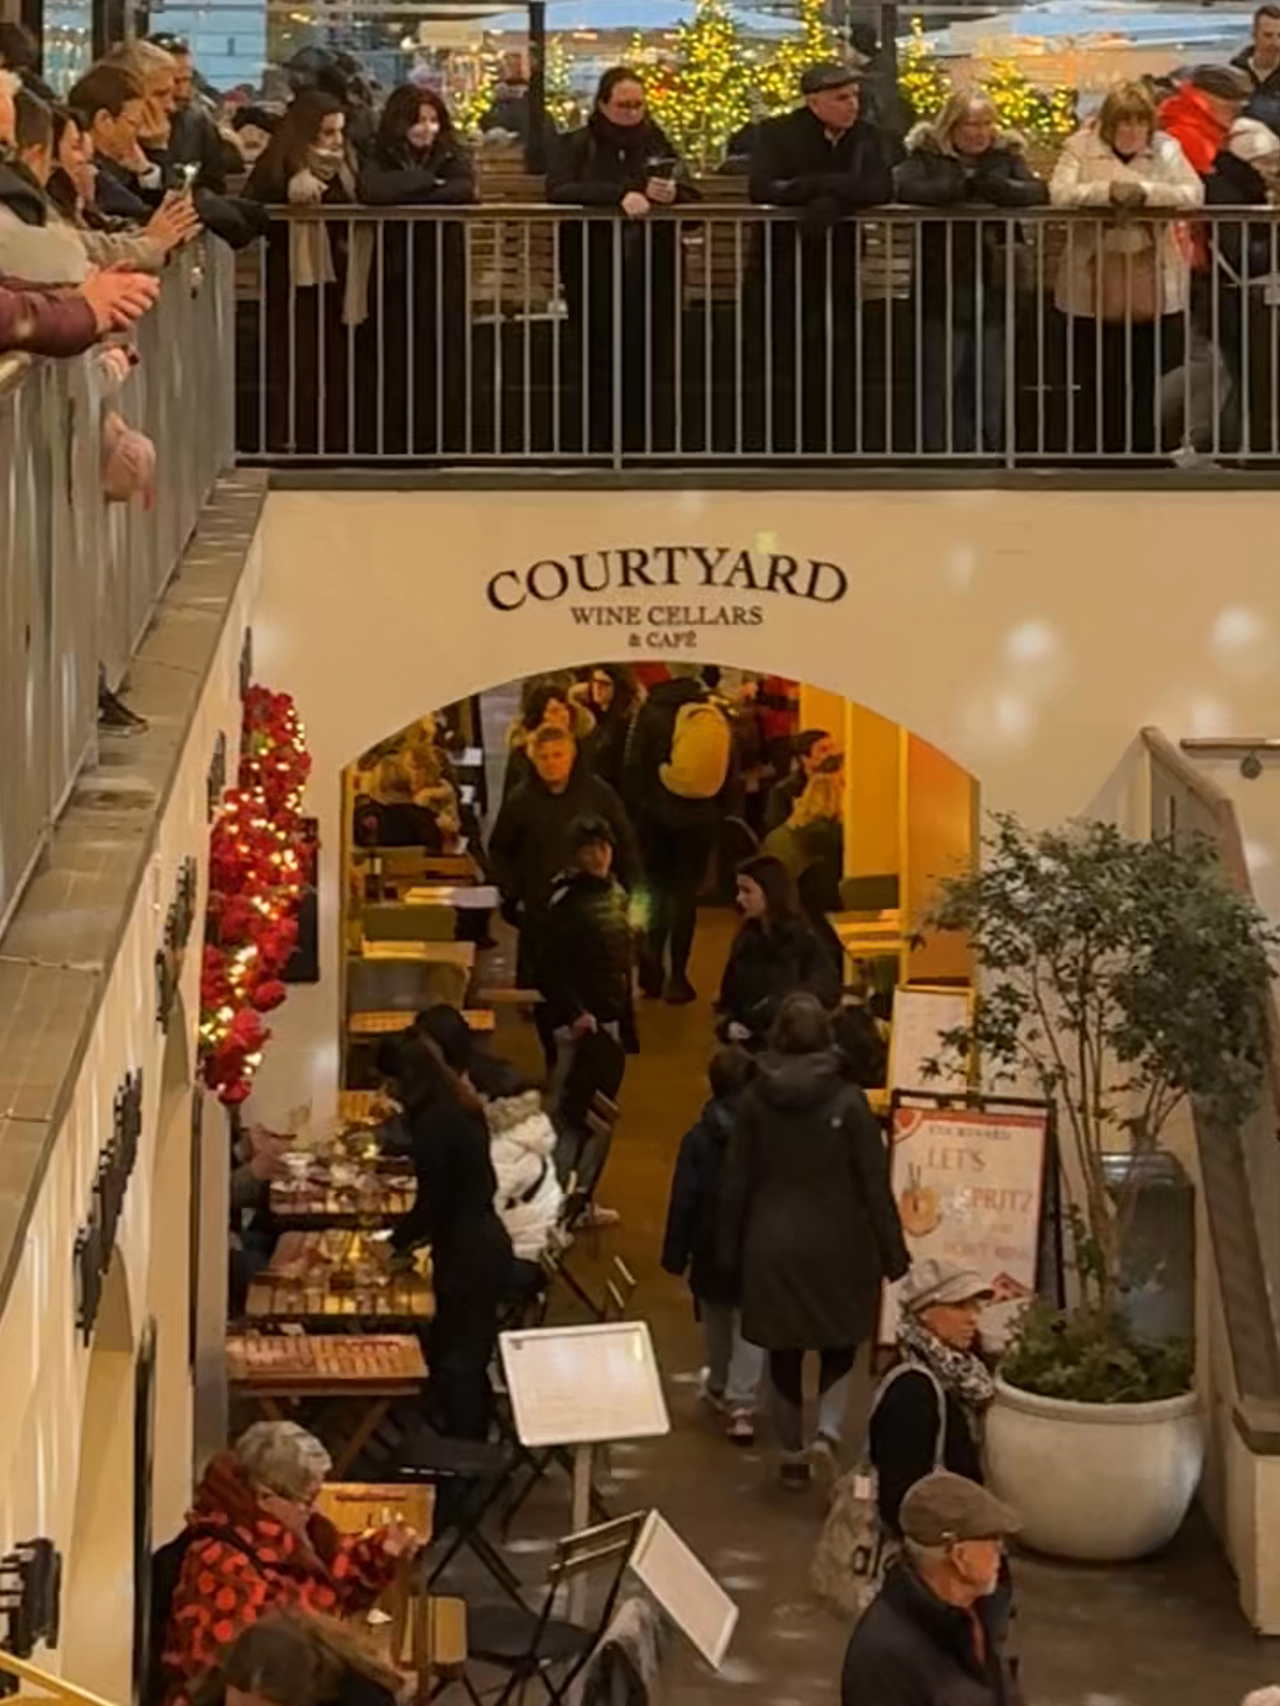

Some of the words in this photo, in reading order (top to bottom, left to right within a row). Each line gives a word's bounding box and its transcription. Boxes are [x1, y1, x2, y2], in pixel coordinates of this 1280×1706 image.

[485, 546, 848, 612] COURTYARD
[570, 605, 642, 626] WINE
[647, 605, 763, 627] CELLARS
[628, 632, 643, 648] &
